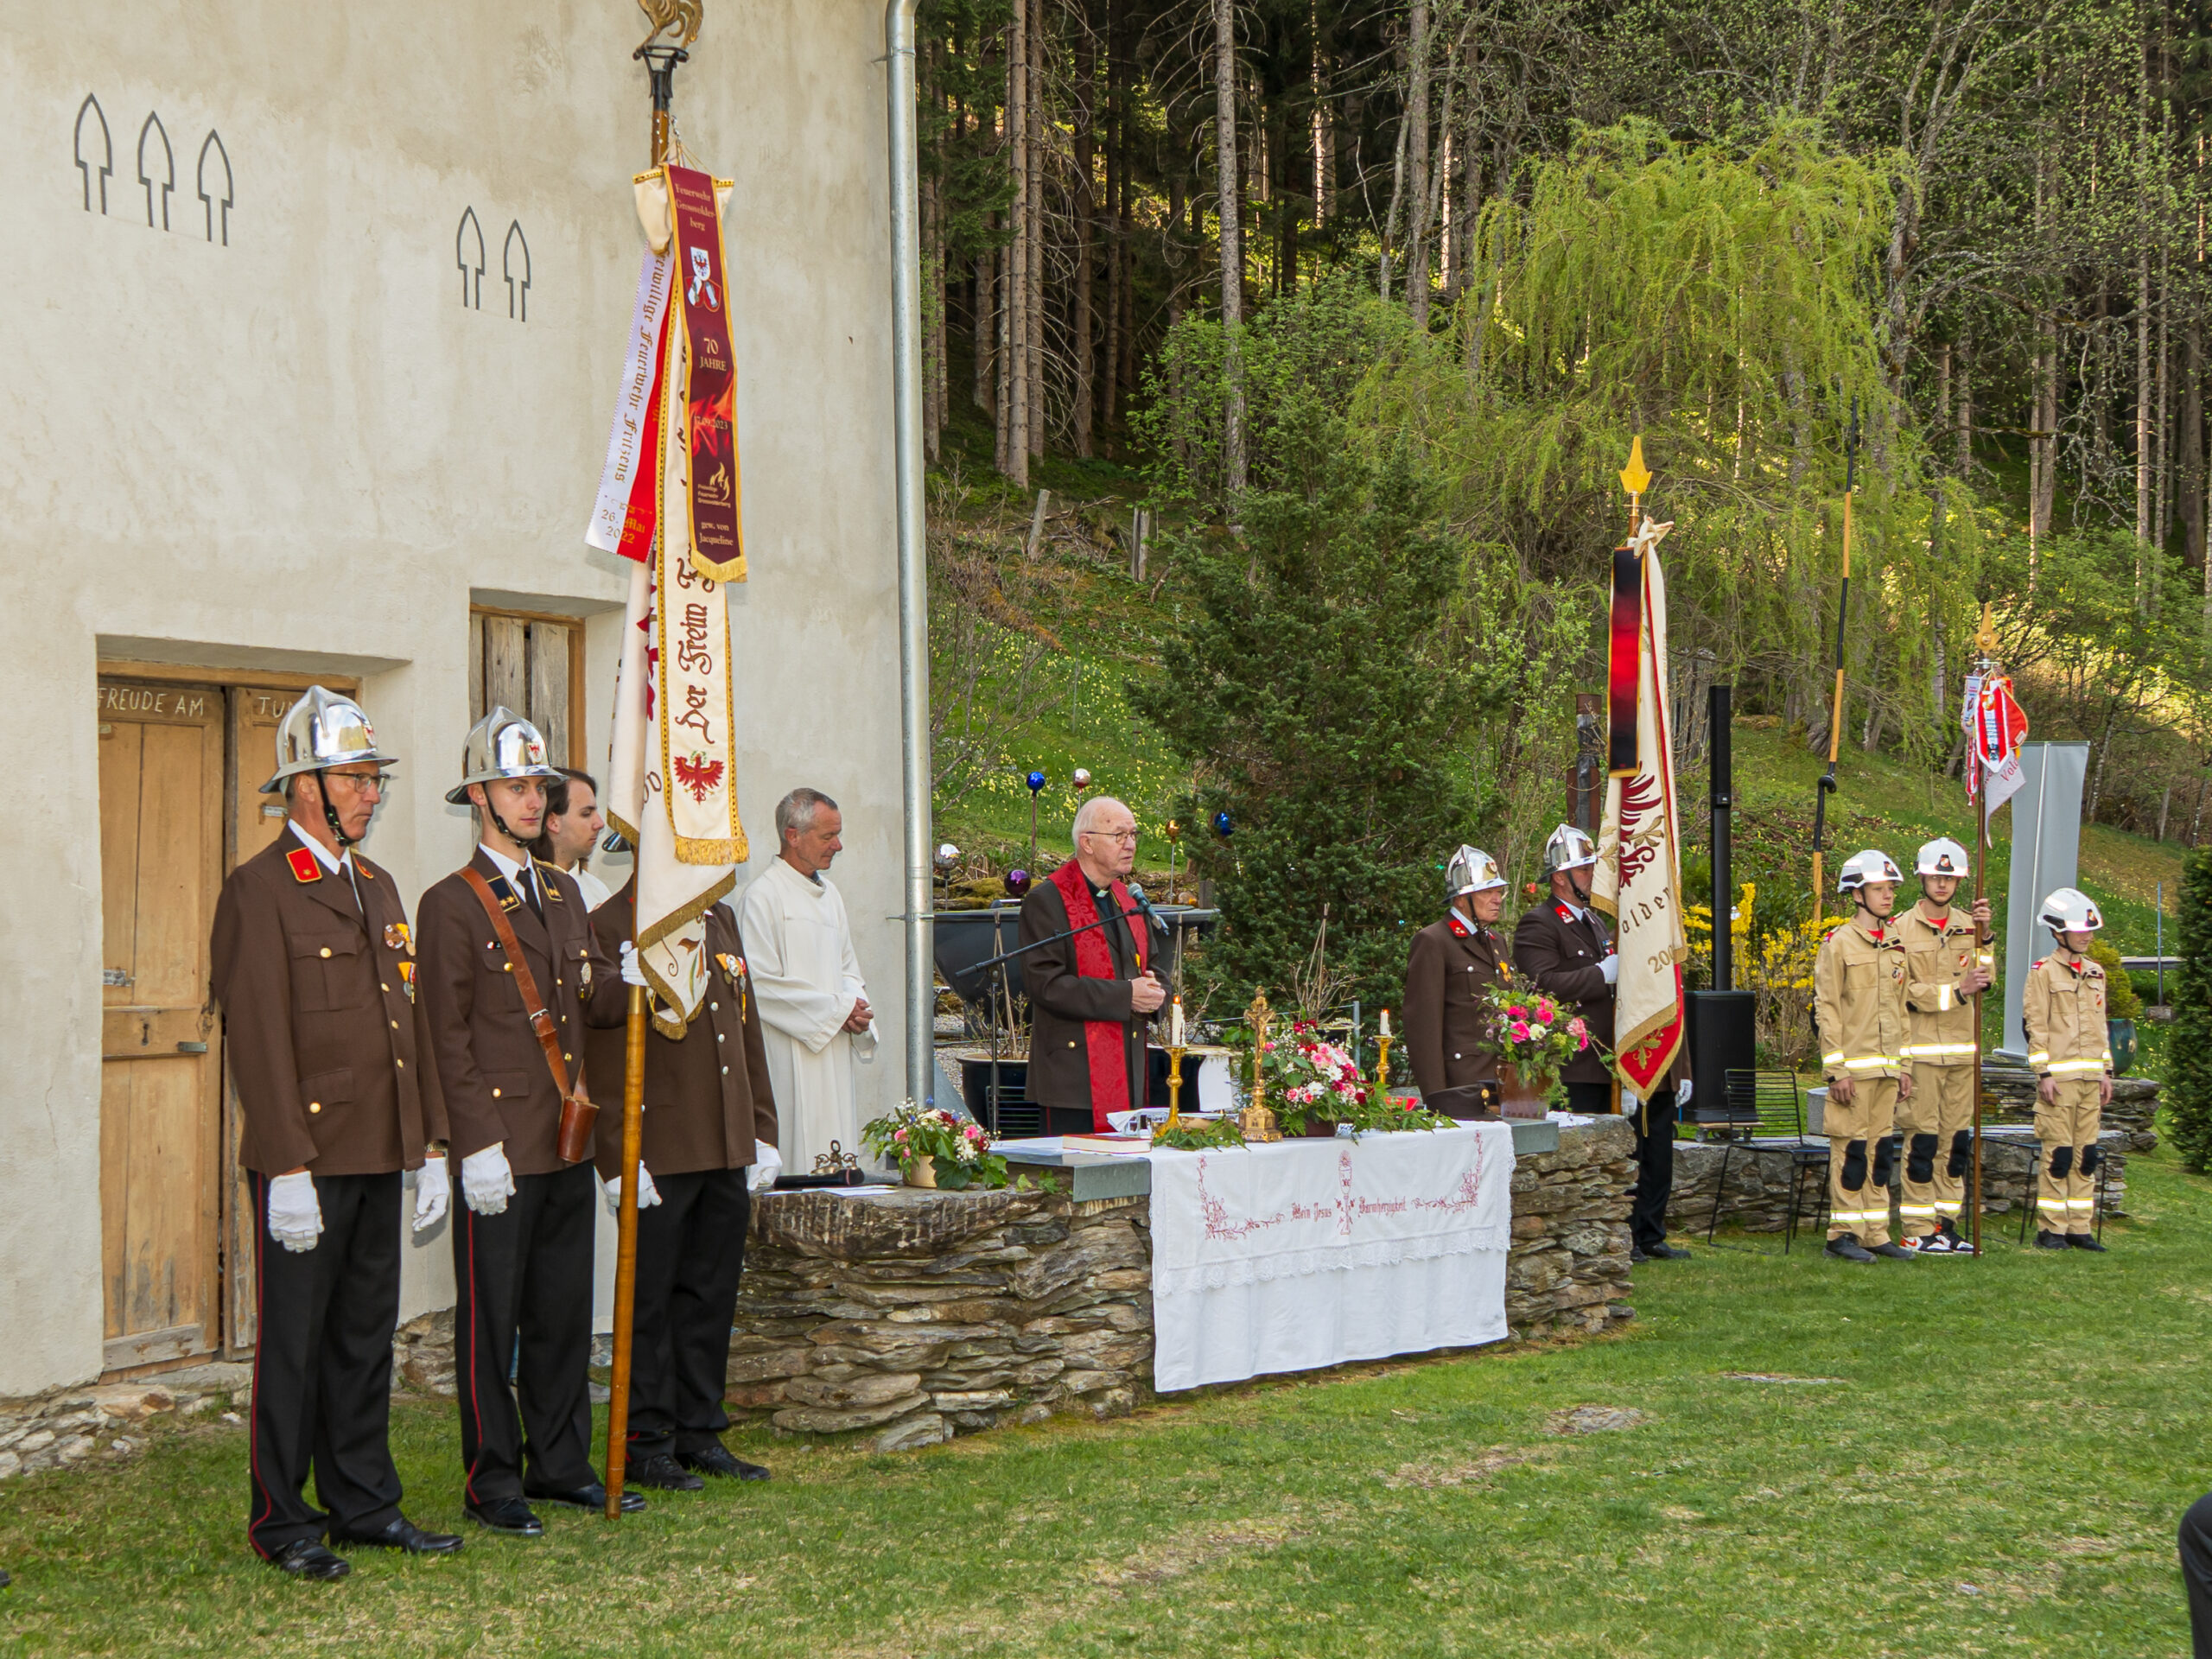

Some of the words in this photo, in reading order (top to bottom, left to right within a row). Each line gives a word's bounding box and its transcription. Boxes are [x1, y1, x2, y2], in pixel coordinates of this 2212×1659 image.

[703, 338, 718, 354] 70
[629, 325, 653, 410] Feuerwehr
[700, 356, 727, 372] JAHRE
[614, 413, 638, 484] Fritzens
[605, 525, 637, 545] 2022
[716, 524, 730, 532] von
[698, 532, 734, 547] Jacqueline
[97, 687, 168, 713] FREUDE
[175, 696, 204, 717] AM
[674, 685, 715, 746] Der
